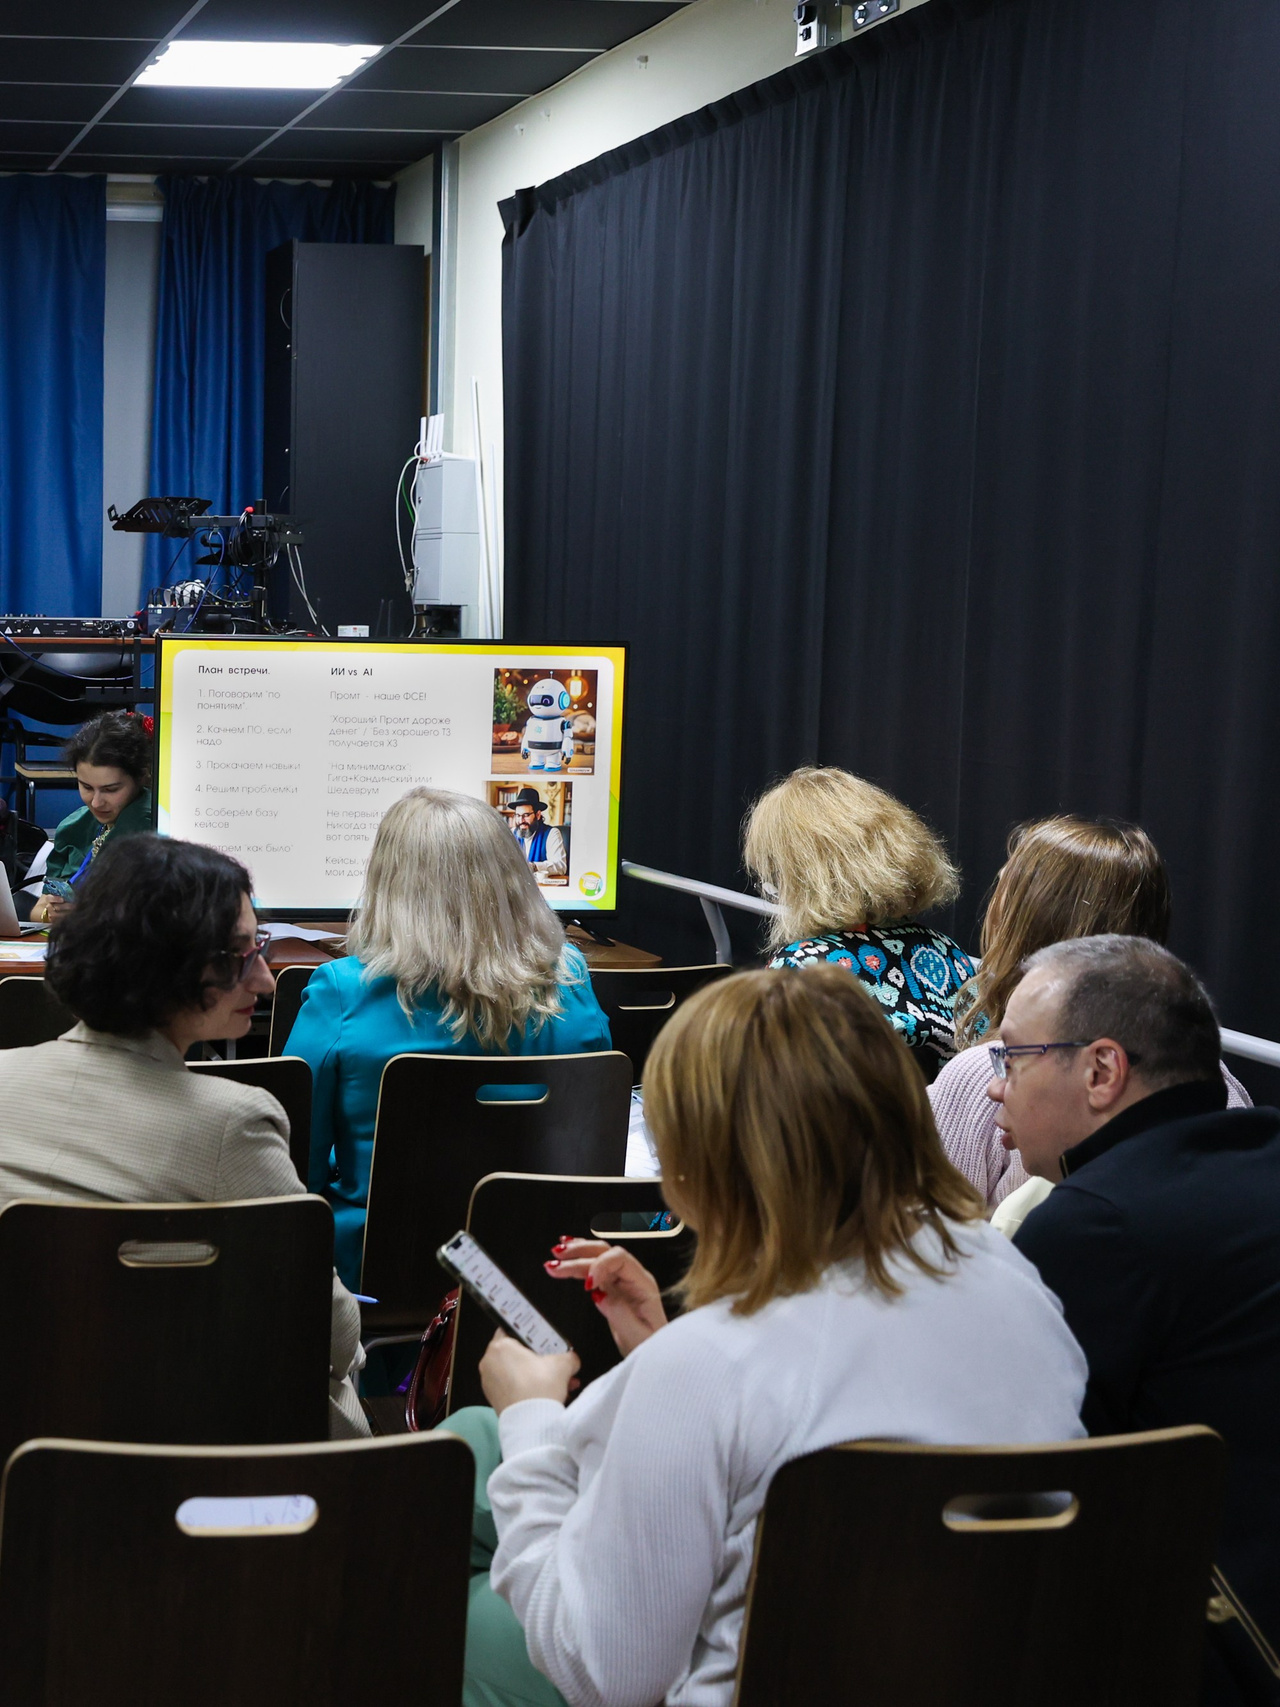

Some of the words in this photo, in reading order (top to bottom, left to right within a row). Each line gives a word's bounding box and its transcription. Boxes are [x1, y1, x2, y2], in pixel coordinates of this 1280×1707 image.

[198, 665, 223, 674] План
[228, 667, 270, 676] встречи.
[331, 667, 345, 675] ИИ
[363, 668, 373, 676] AI
[208, 689, 263, 699] Поговорим
[329, 691, 361, 701] Промт
[373, 693, 401, 701] наше
[403, 692, 427, 701] ФСЕ!
[379, 716, 410, 725] Промт
[412, 718, 451, 726] дороже
[196, 725, 205, 733] 2.
[207, 725, 245, 734] Качнем
[392, 729, 440, 738] хорошего
[328, 739, 385, 748] получается
[206, 761, 263, 770] Прокачаем
[327, 774, 413, 783] Гига+Кандинский
[205, 784, 240, 793] Решим
[327, 786, 380, 796] Шедеврум
[255, 808, 279, 818] базу
[326, 810, 340, 818] Не
[342, 810, 378, 819] первый
[195, 820, 229, 829] кейсов
[326, 821, 367, 830] Никогда
